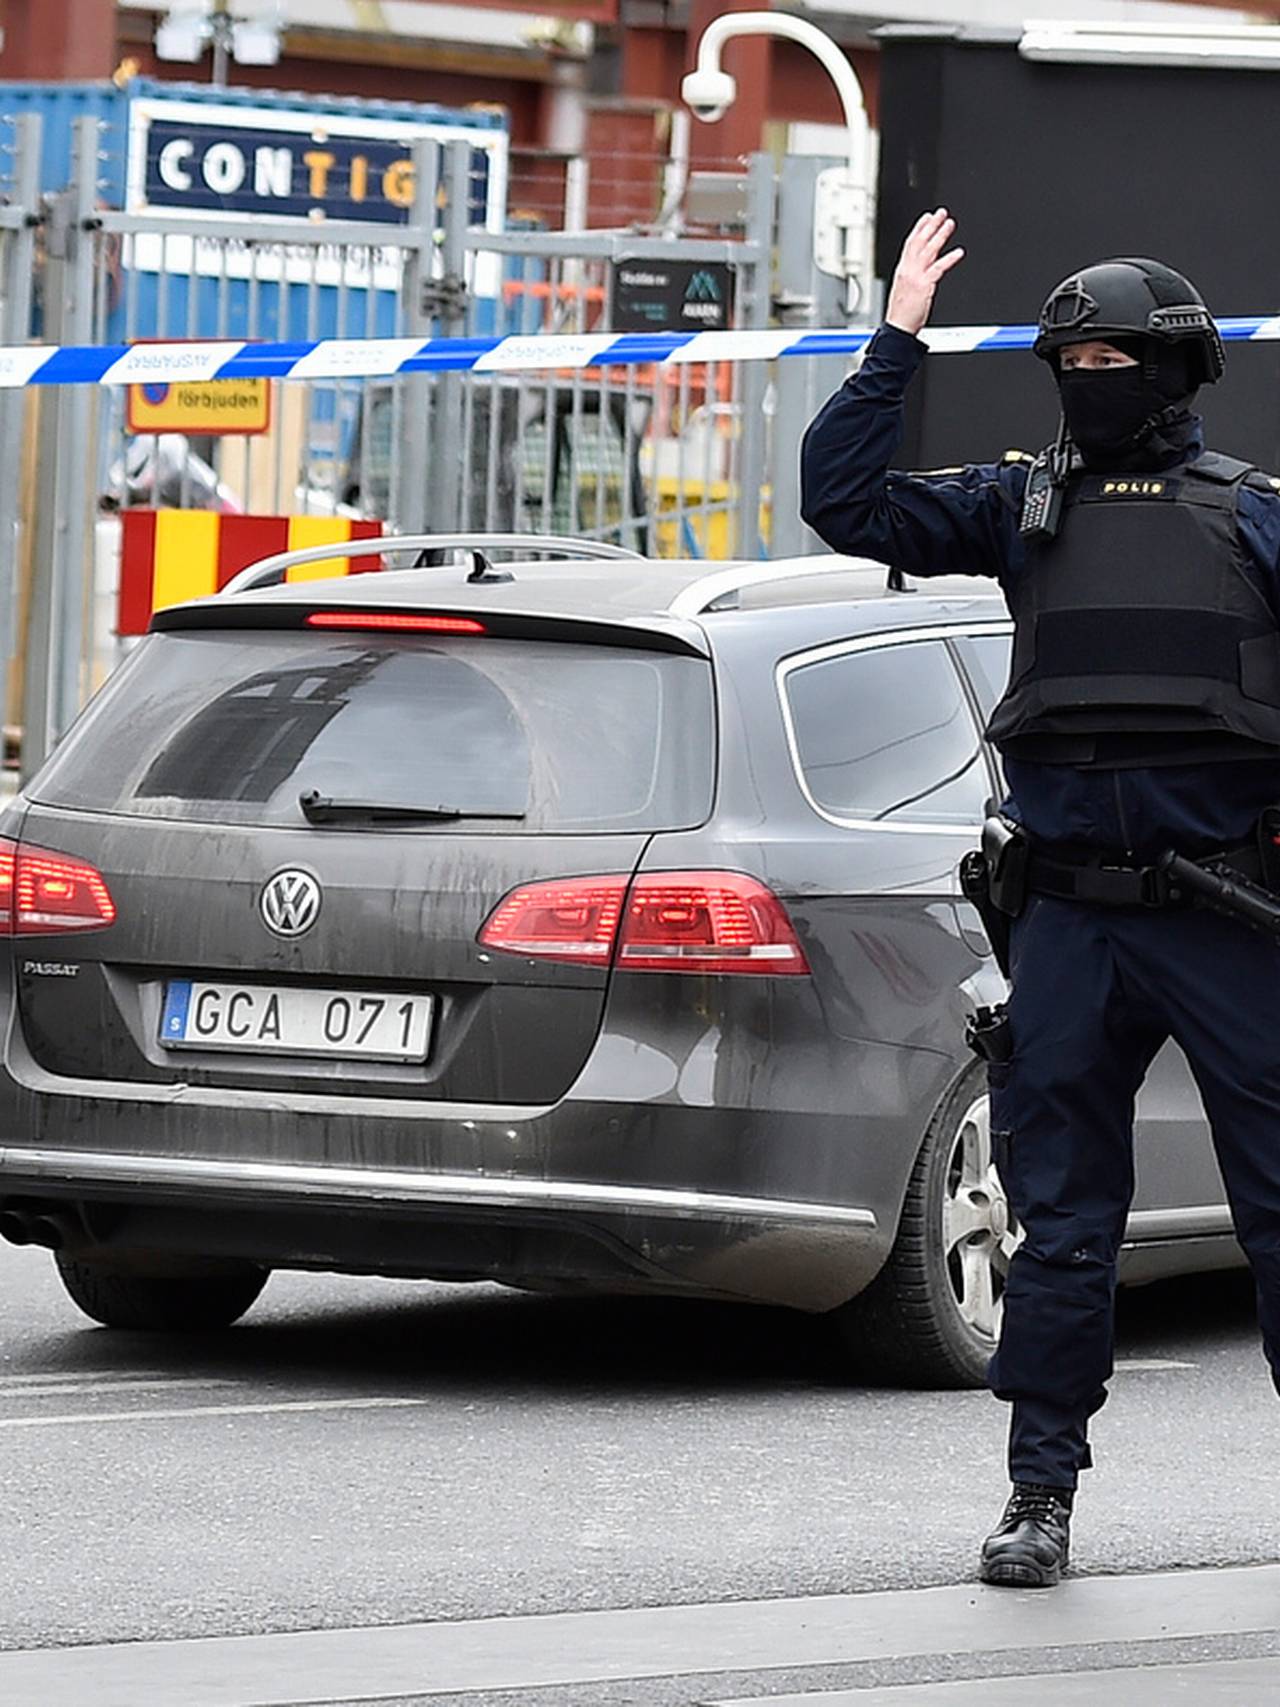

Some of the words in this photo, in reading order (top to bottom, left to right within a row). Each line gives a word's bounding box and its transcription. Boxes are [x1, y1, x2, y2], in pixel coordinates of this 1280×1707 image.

[159, 138, 447, 209] CONTIG
[177, 389, 259, 409] förbjuden
[1104, 482, 1163, 494] POLIS
[23, 961, 81, 977] PASSAT
[170, 1016, 181, 1031] S
[195, 989, 280, 1040] GCA
[323, 997, 414, 1048] 071
